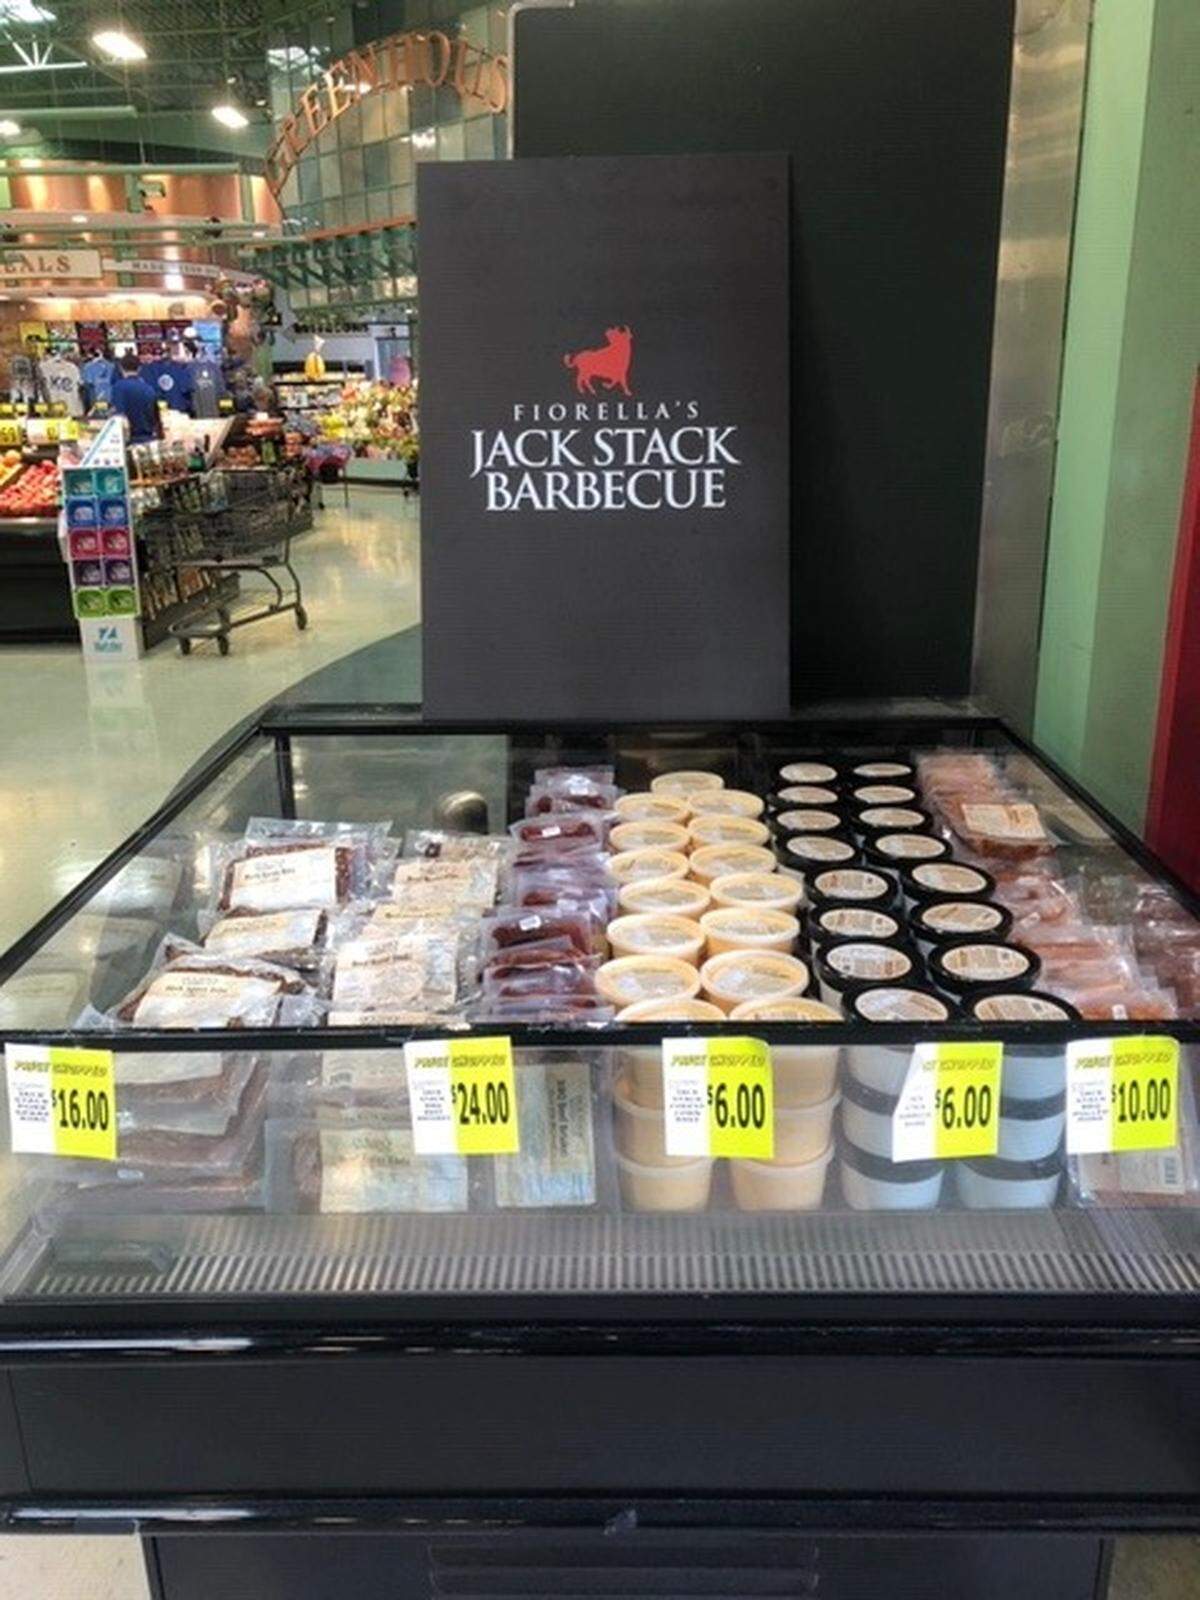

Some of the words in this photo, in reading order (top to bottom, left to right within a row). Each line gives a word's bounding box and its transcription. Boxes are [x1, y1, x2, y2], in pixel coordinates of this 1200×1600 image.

[513, 401, 700, 421] FIORELLA'S
[470, 429, 583, 479] JACK
[594, 425, 741, 466] STACK
[485, 468, 727, 511] BARBECUE
[51, 1088, 109, 1131] $16.00
[451, 1081, 509, 1125] $24.00
[707, 1082, 766, 1130] $6.00
[935, 1084, 992, 1130] $6.00
[1111, 1077, 1171, 1123] $10.00
